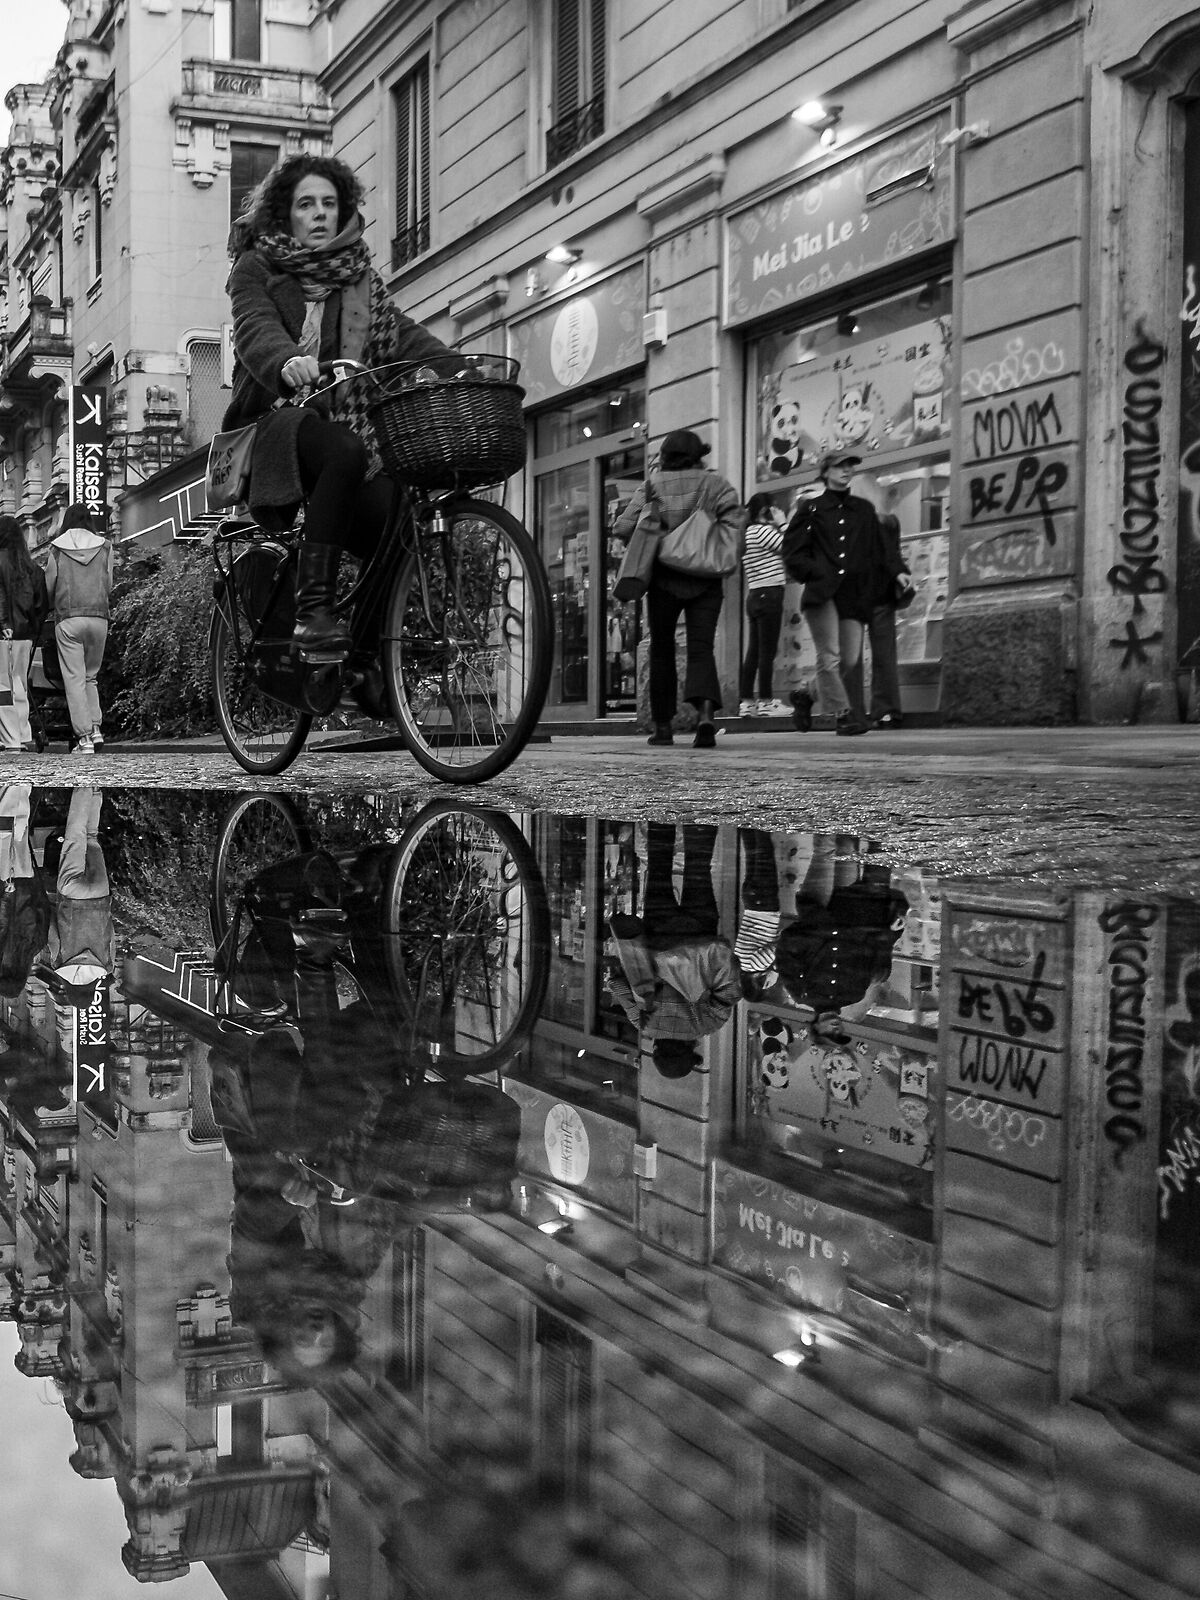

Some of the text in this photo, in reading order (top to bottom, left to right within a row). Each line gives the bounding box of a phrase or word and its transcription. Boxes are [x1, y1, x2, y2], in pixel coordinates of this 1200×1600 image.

[753, 242, 788, 281] Mei
[790, 232, 823, 264] Jia
[826, 220, 855, 251] Le
[75, 444, 85, 466] Sushi
[84, 443, 105, 516] Kaiseki
